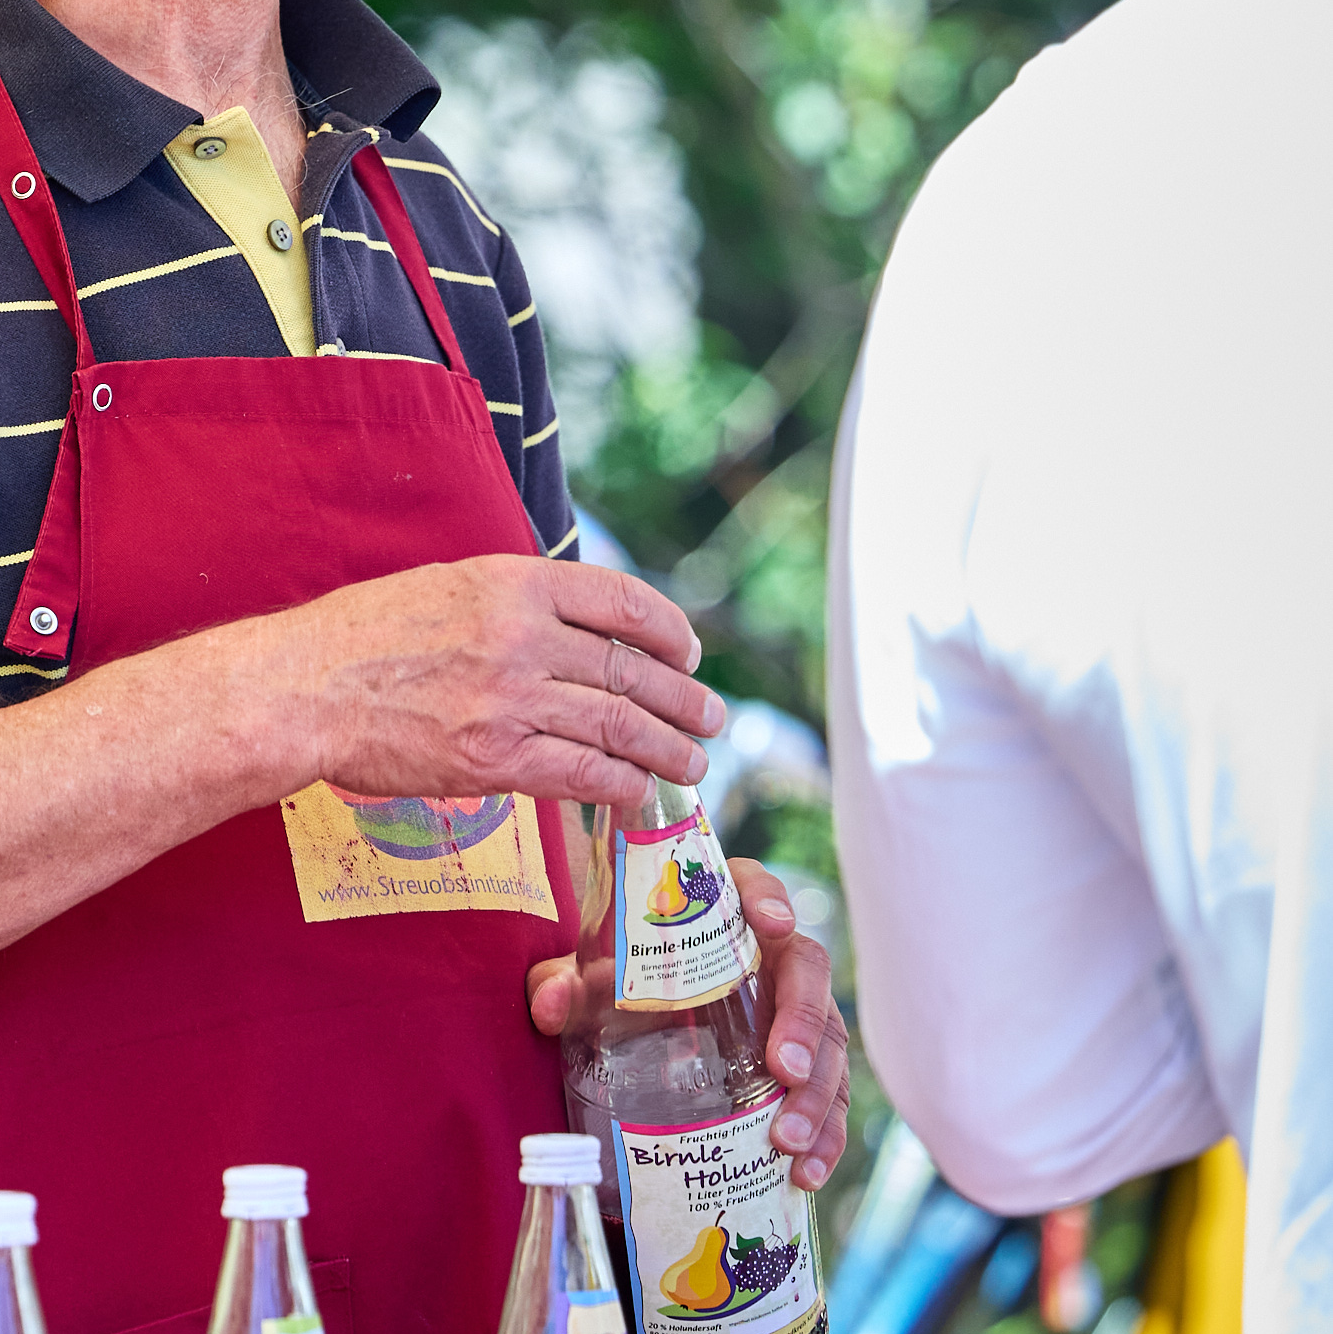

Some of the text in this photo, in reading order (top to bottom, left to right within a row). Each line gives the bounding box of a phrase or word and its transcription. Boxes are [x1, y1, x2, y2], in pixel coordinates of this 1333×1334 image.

[317, 872, 547, 904] www.Streuobstinitiative.de
[641, 959, 683, 972] Birnensaft
[684, 956, 699, 966] aus
[643, 973, 655, 982] im
[656, 970, 681, 981] Stadt-
[683, 968, 699, 976] und
[682, 976, 697, 986] mit
[679, 1111, 771, 1145] Fruchtig-frischer
[629, 1143, 735, 1167] Birnle-
[687, 1167, 777, 1201] 1 Liter Direktsaft
[688, 1173, 786, 1213] 100 % Fruchtgehalt
[648, 1322, 723, 1333] 20 % Holundersaft
